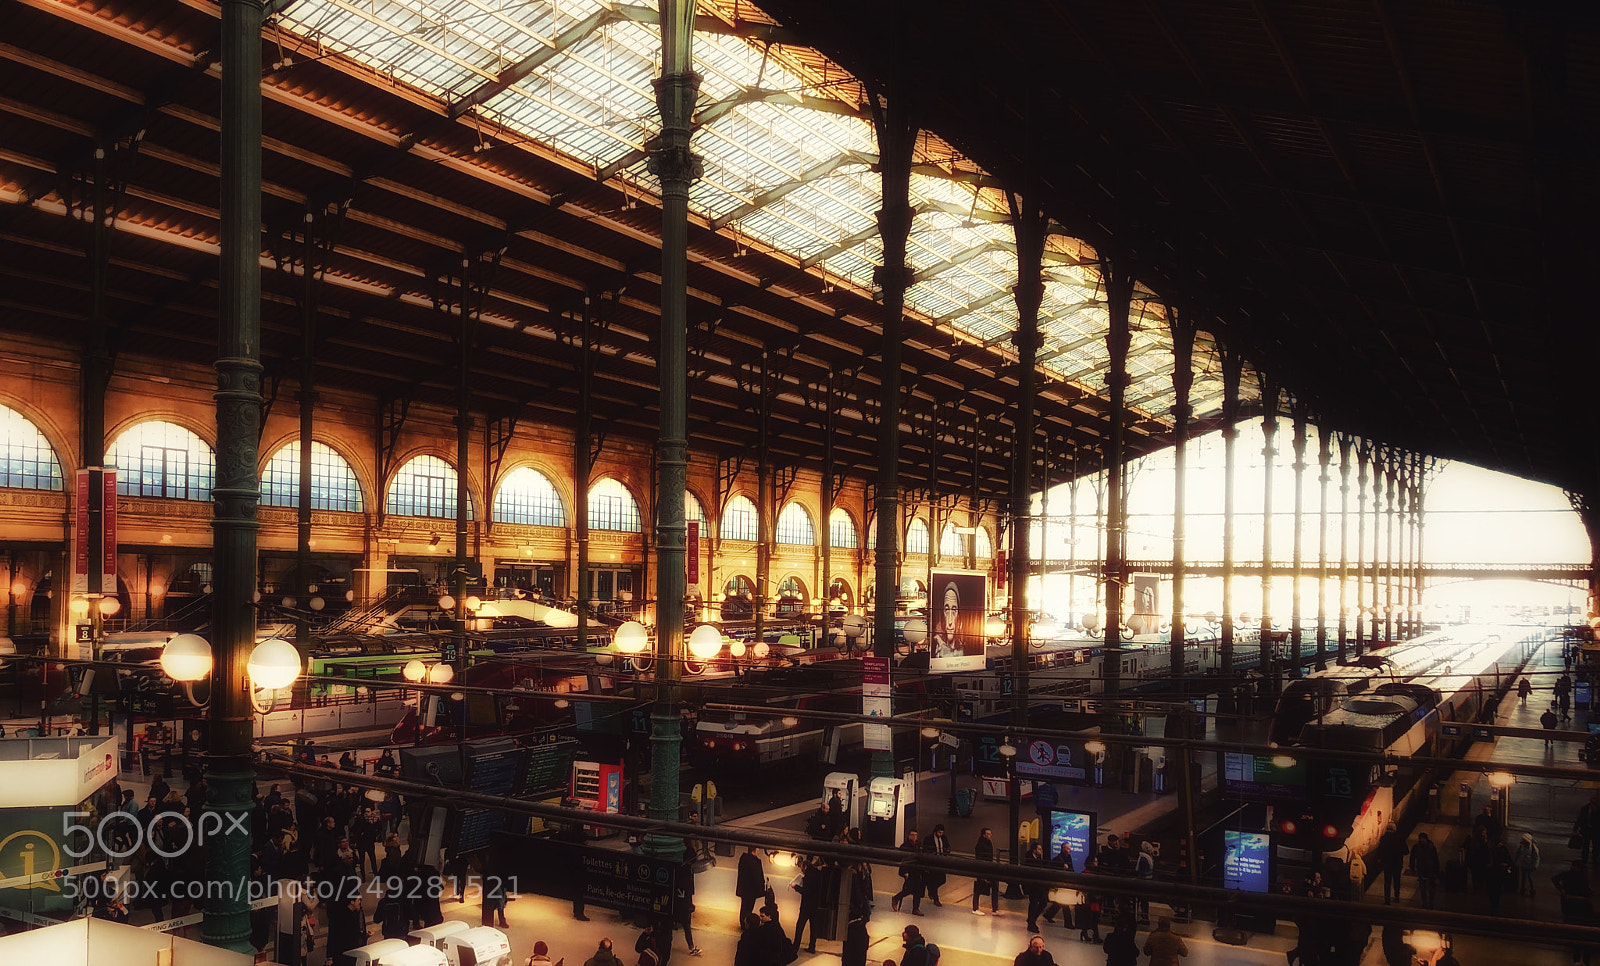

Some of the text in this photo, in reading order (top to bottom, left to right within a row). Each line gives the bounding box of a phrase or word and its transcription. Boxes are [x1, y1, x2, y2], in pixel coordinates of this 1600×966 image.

[82, 630, 89, 639] 8
[622, 659, 632, 670] 11
[1003, 679, 1012, 693] 12
[631, 717, 647, 732] 11
[980, 744, 1001, 761] 12
[1325, 776, 1352, 795] 13
[582, 855, 613, 870] Toilettes
[587, 884, 605, 897] Paris,
[168, 919, 184, 929] AREA
